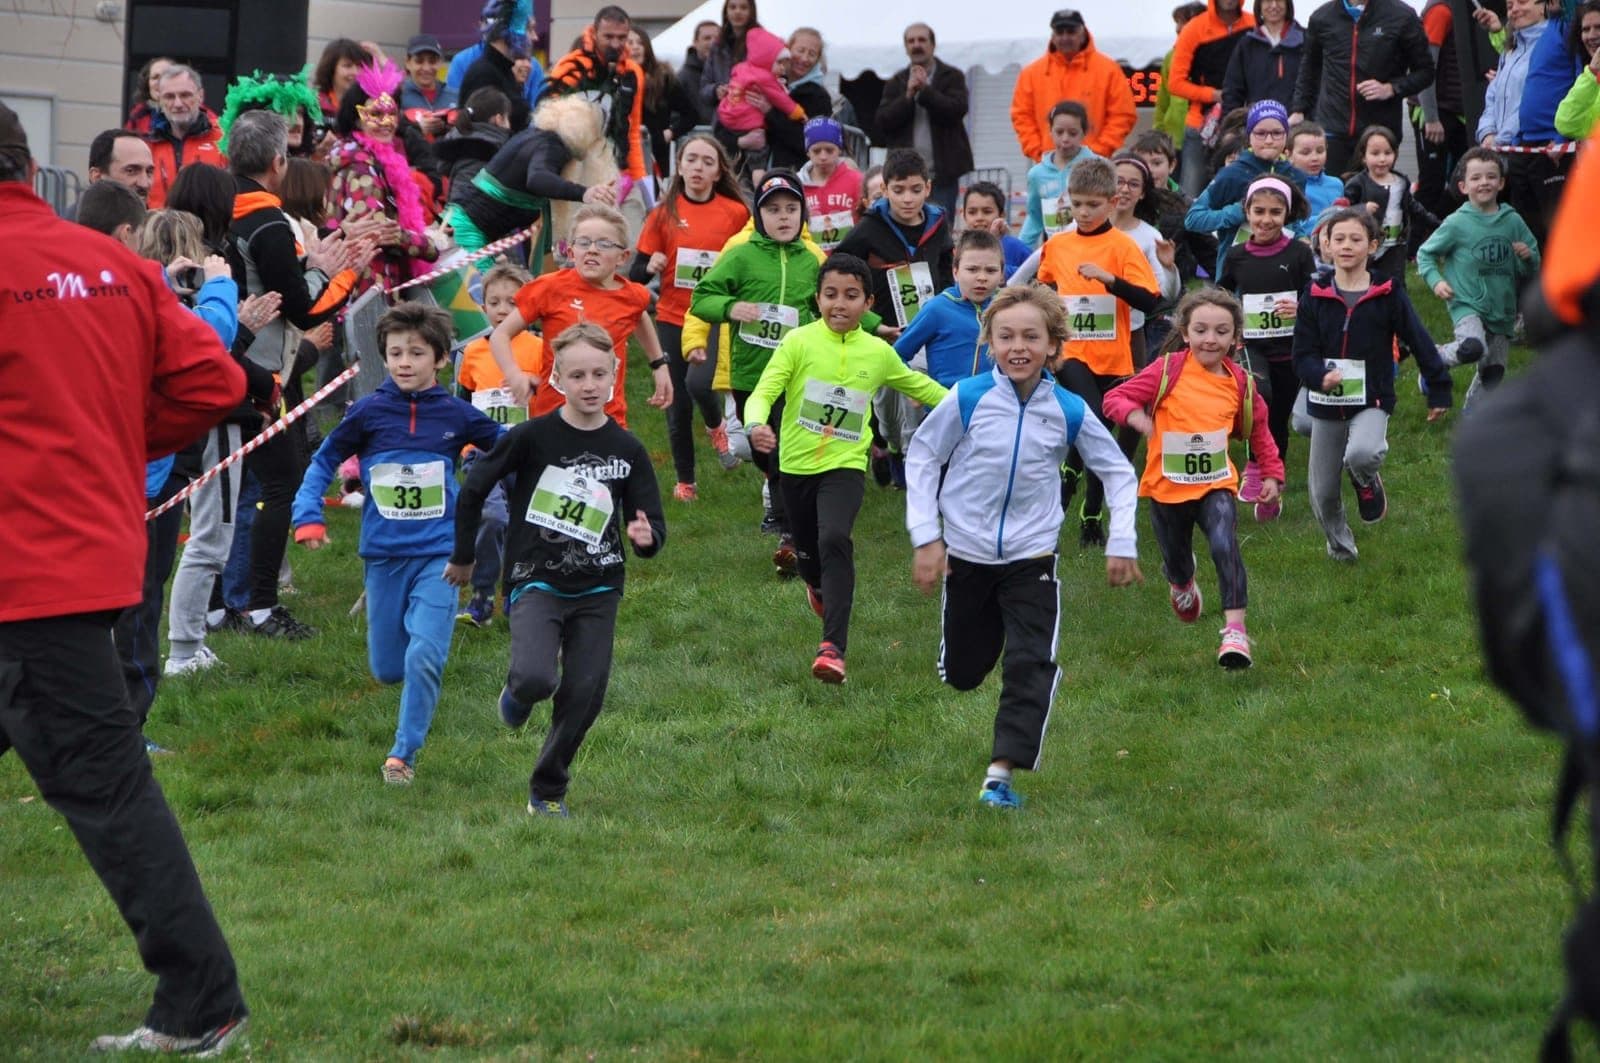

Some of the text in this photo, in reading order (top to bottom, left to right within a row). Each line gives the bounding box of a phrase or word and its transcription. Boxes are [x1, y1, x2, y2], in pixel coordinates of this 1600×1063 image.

[822, 228, 841, 243] 42
[1480, 243, 1510, 263] TEAM
[900, 284, 919, 306] 43
[759, 319, 782, 340] 39
[1073, 313, 1096, 332] 44
[1259, 311, 1282, 330] 36
[819, 404, 848, 428] 37
[1185, 452, 1212, 475] 66
[393, 485, 422, 510] 33
[528, 512, 548, 525] CROSS
[548, 519, 556, 527] DE
[553, 495, 587, 527] 34
